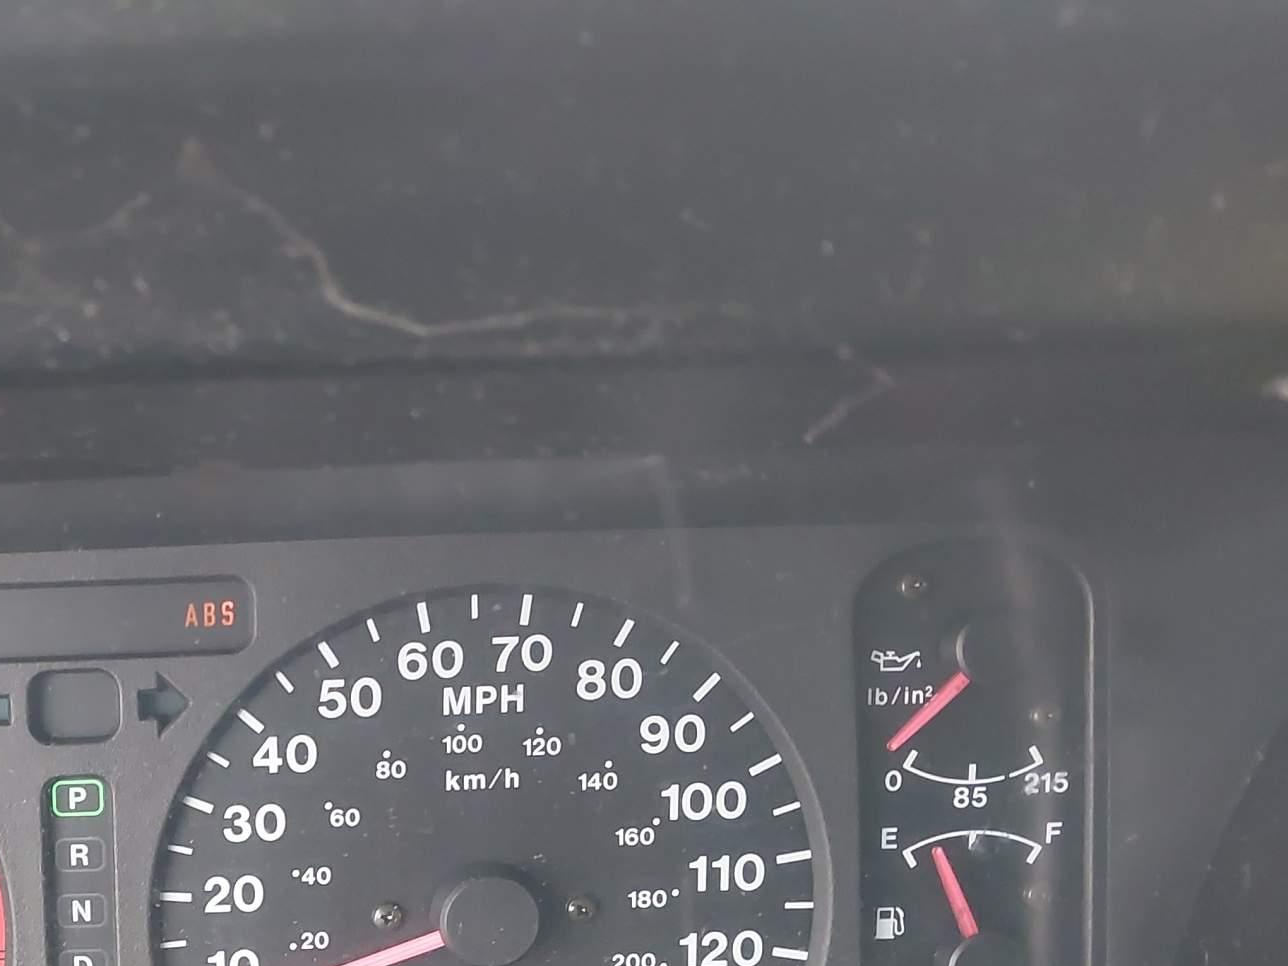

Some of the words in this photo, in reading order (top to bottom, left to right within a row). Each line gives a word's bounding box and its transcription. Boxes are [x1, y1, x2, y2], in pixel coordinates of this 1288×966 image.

[185, 600, 234, 627] ABS
[397, 640, 464, 681] 60
[491, 634, 553, 673] 70
[576, 658, 643, 701] 80
[318, 677, 382, 719] 50
[443, 683, 524, 716] MPH
[442, 734, 483, 754] 100
[522, 736, 562, 756] 120
[639, 714, 706, 754] 90
[253, 734, 317, 773] 40
[375, 760, 407, 780] 80
[445, 767, 520, 792] km/h
[578, 772, 618, 791] 140
[884, 770, 902, 792] 0
[1023, 771, 1069, 795] 215
[69, 786, 87, 810] P
[661, 780, 747, 821] 100
[953, 786, 988, 809] 85
[223, 803, 286, 843] 30
[329, 808, 360, 827] 60
[615, 827, 655, 846] 160
[881, 827, 898, 850] E
[1045, 821, 1063, 844] F
[70, 843, 89, 866] R
[301, 866, 332, 885] 40
[688, 853, 765, 892] 110
[203, 875, 264, 914] 20
[627, 889, 668, 909] 180
[71, 899, 91, 923] N
[300, 931, 330, 950] 20
